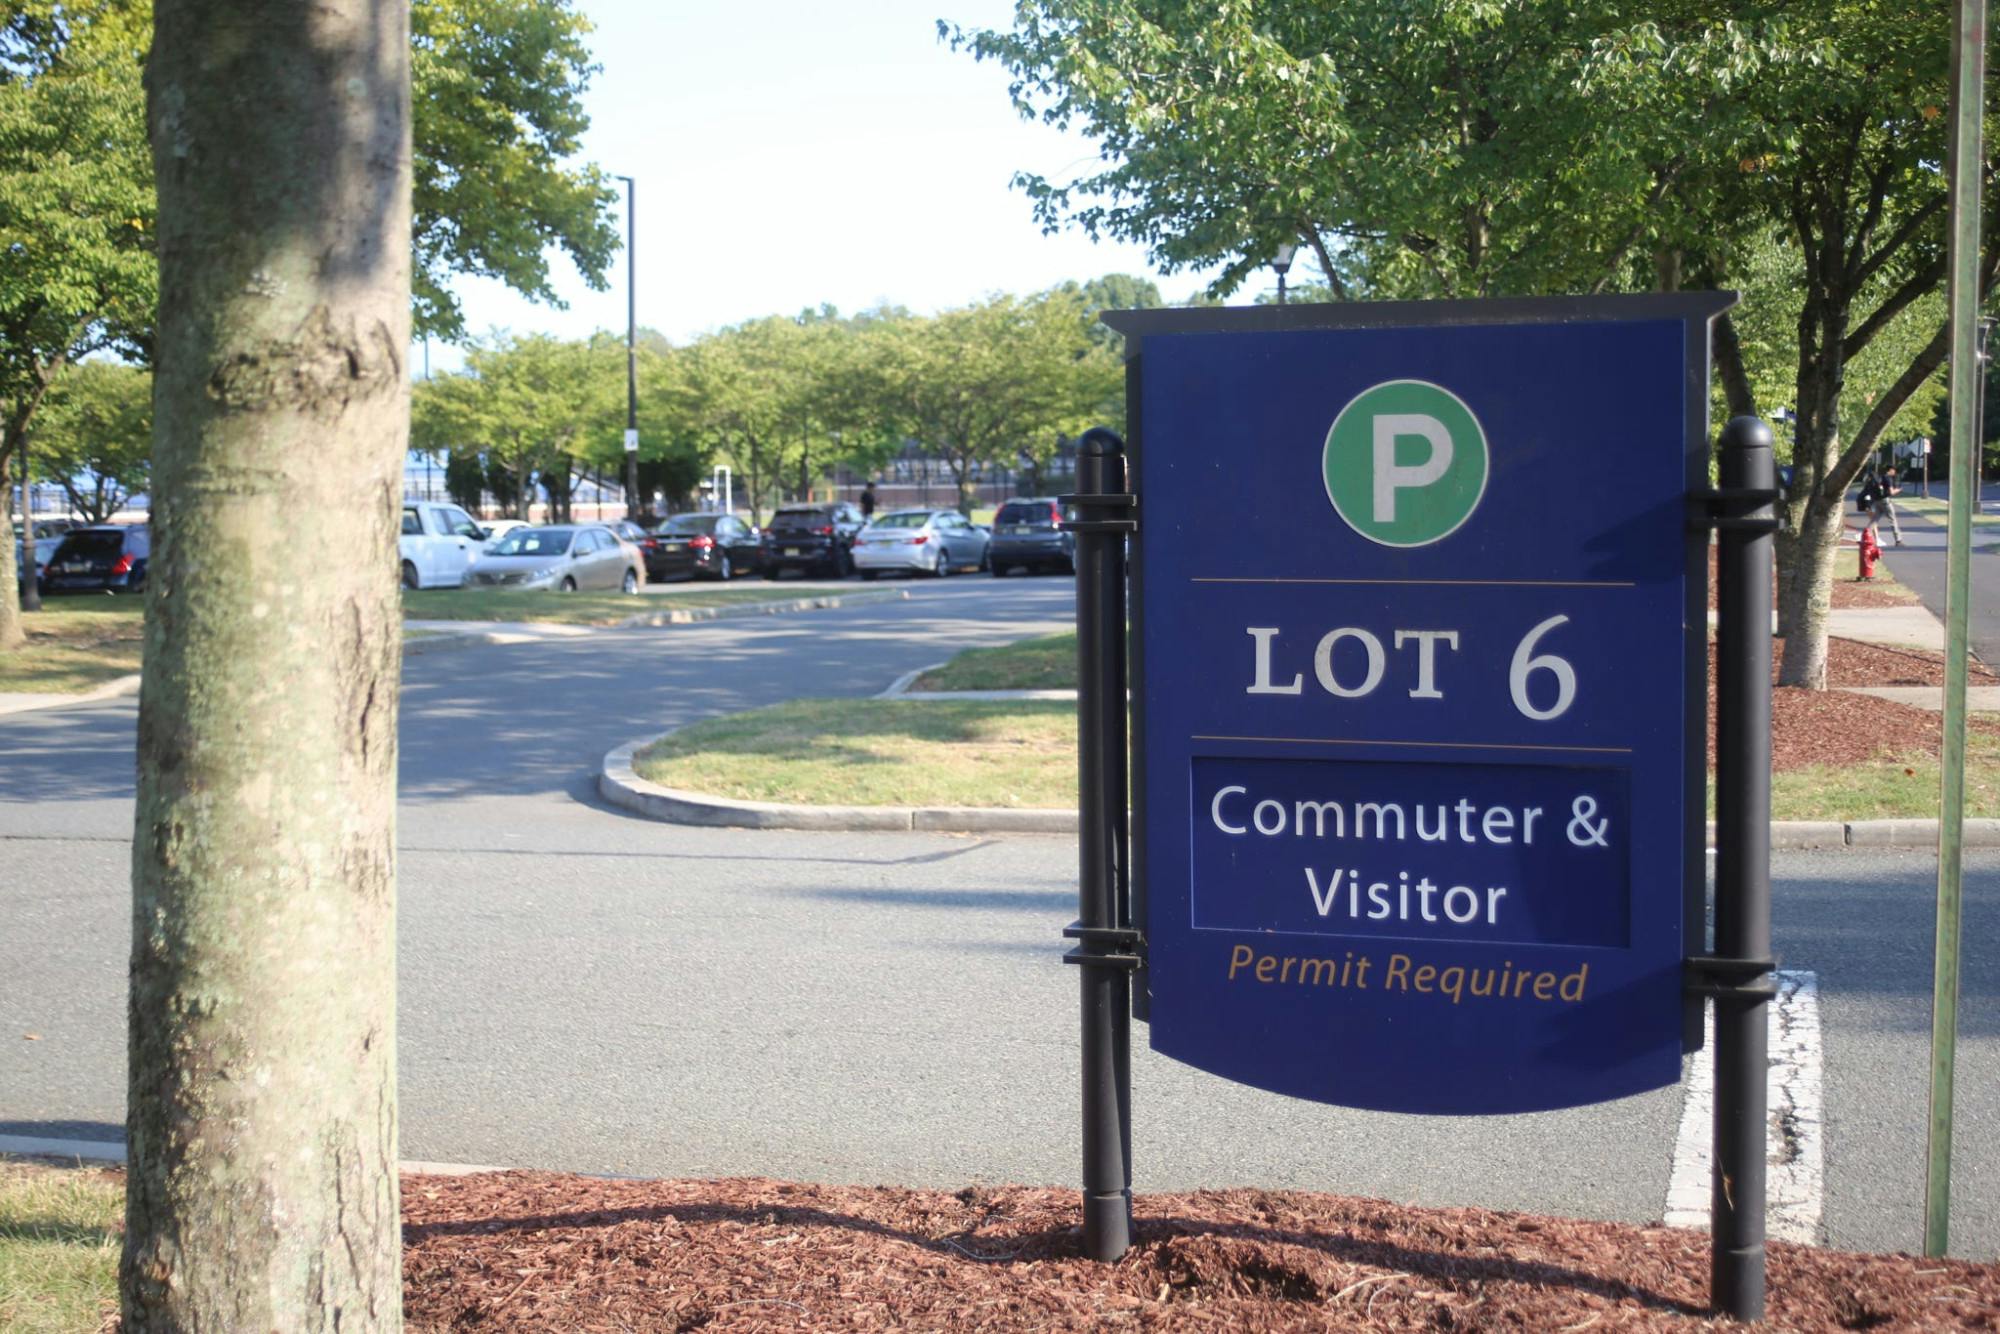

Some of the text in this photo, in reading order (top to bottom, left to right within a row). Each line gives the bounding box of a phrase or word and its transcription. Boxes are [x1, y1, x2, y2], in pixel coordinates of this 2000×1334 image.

[1373, 414, 1454, 524] P
[1246, 614, 1577, 721] LOT 6
[1211, 785, 1609, 847] Commuter &
[1304, 867, 1507, 924] Visitor
[1229, 945, 1588, 1004] Permit Required
